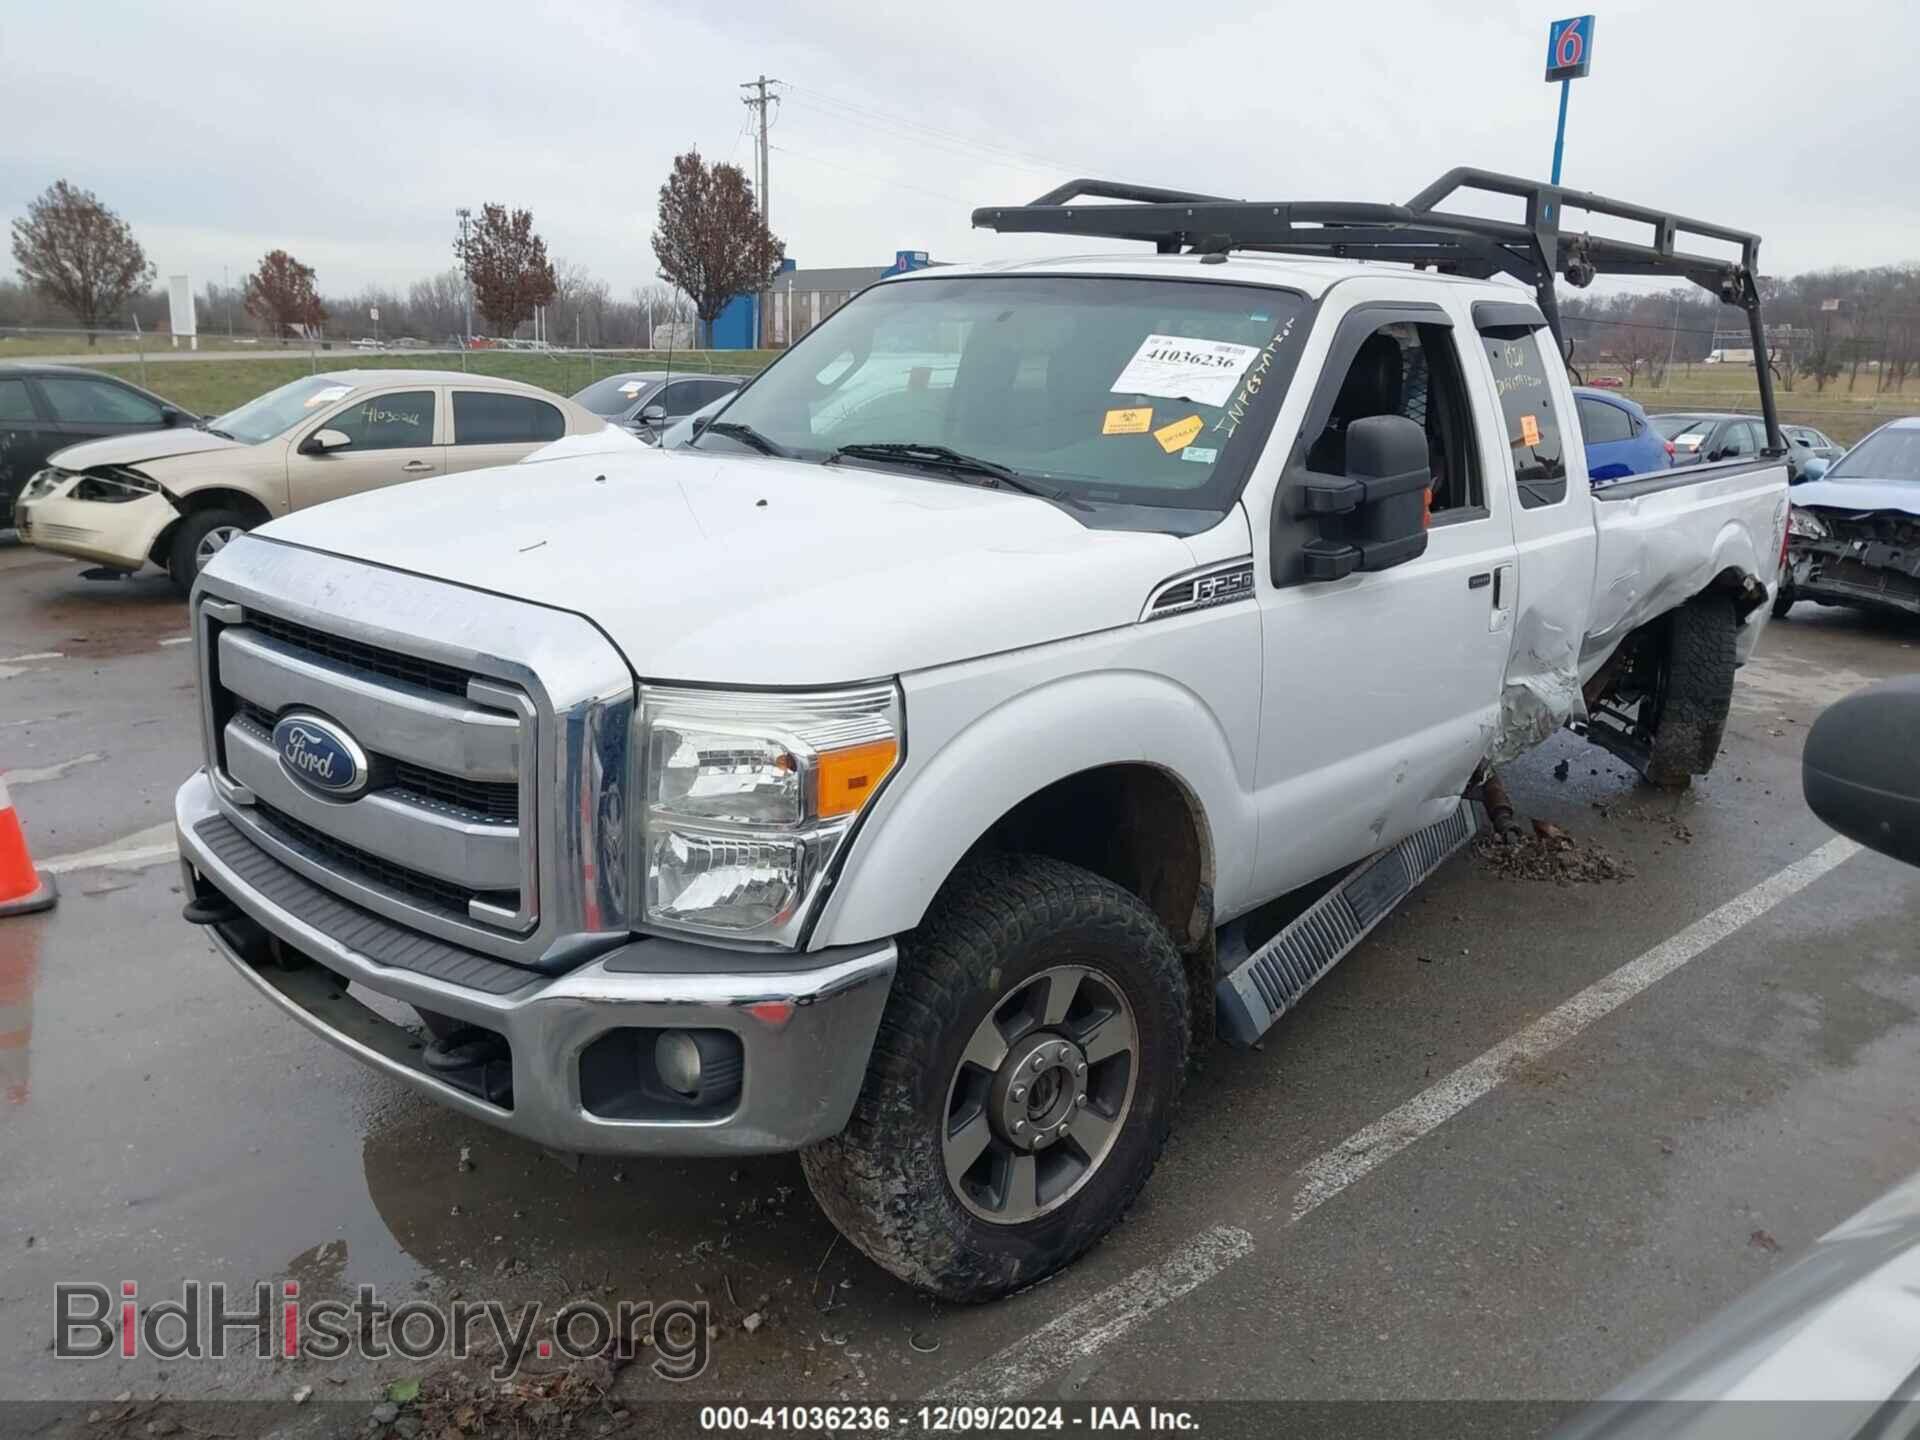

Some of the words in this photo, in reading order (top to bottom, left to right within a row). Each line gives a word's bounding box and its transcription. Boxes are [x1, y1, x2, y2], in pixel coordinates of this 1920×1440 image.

[1556, 18, 1583, 67] 6
[1146, 348, 1236, 369] 41036236
[286, 726, 334, 778] Ford
